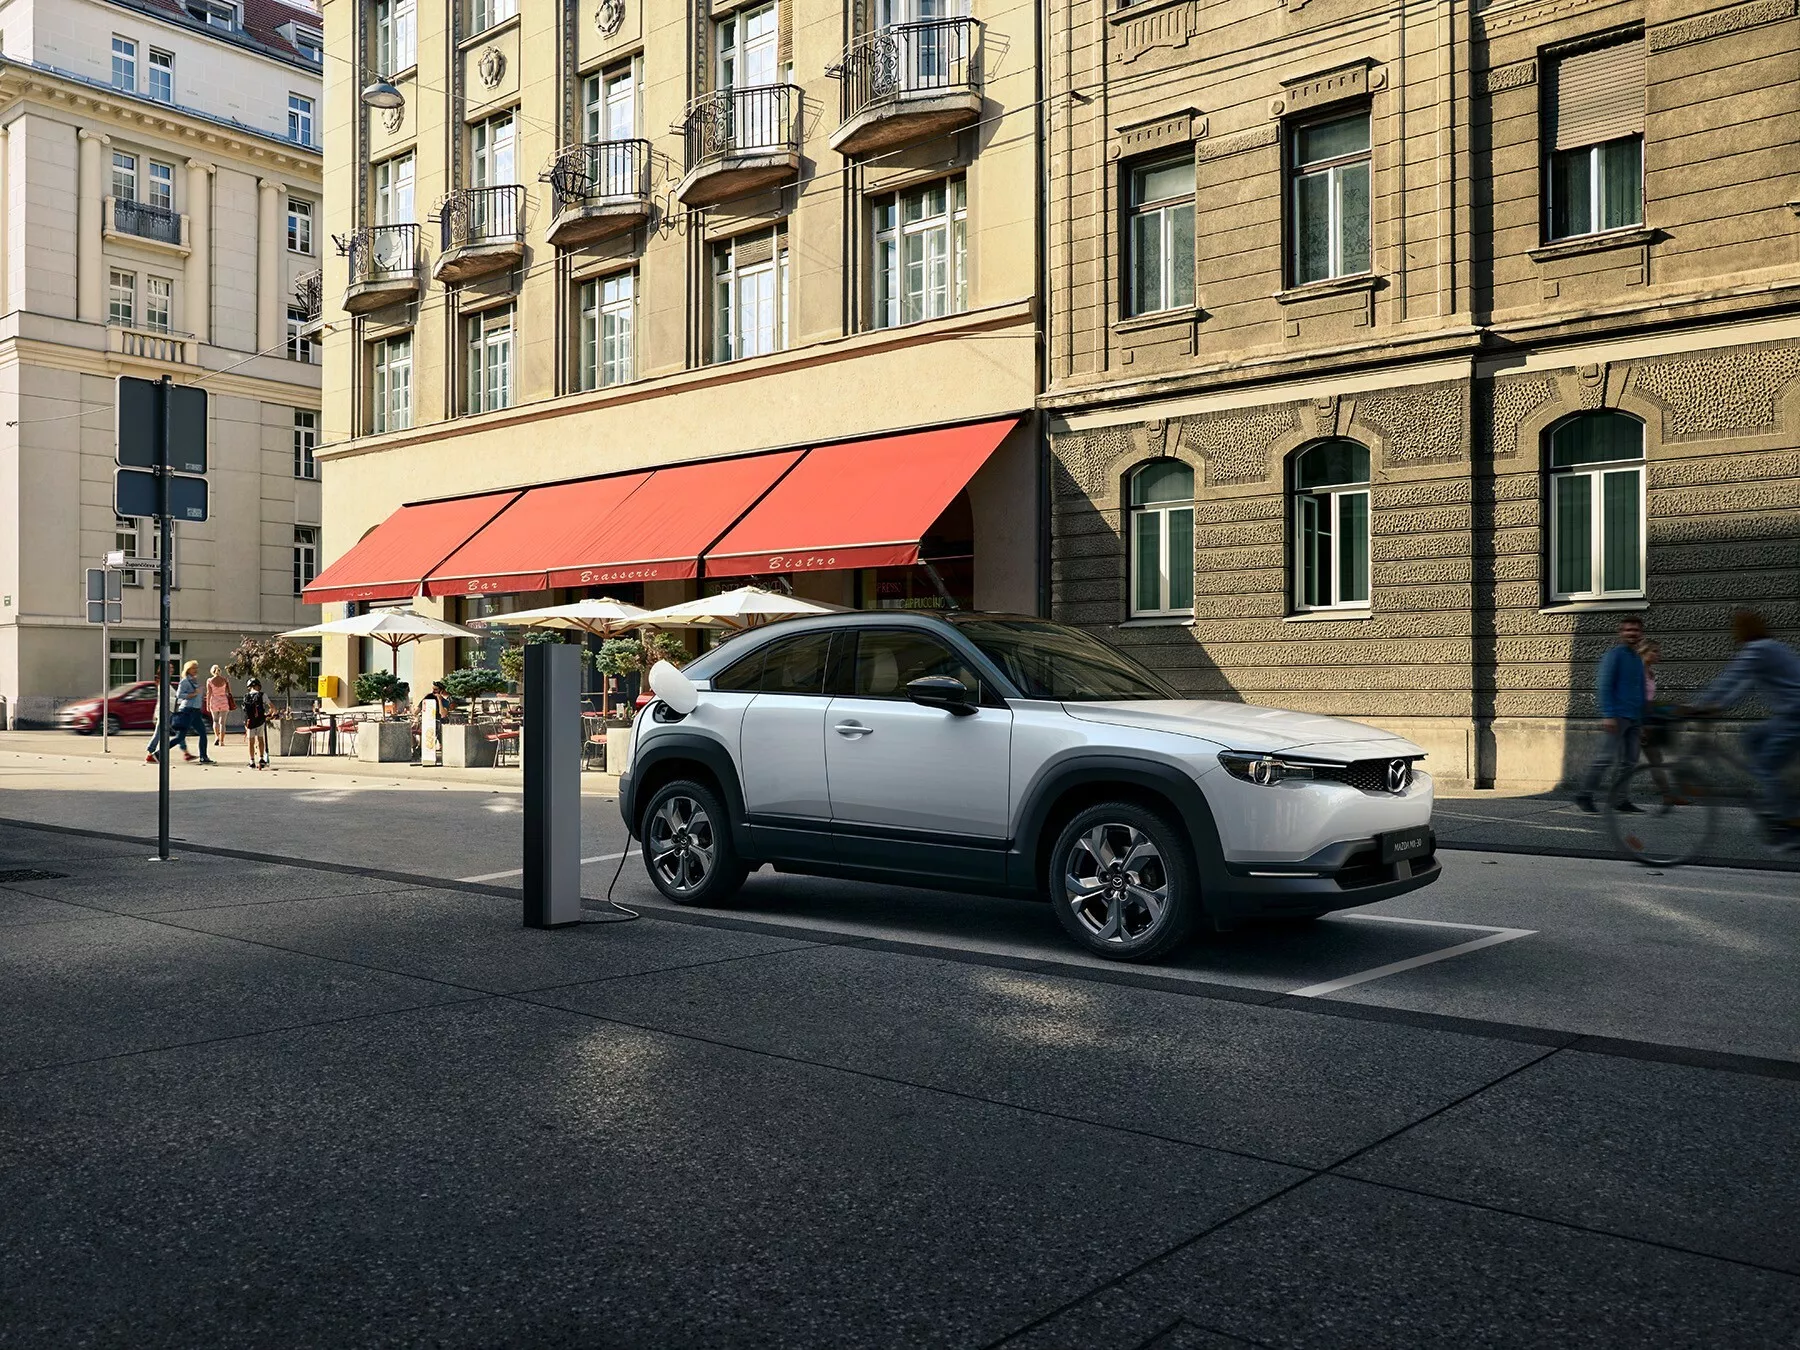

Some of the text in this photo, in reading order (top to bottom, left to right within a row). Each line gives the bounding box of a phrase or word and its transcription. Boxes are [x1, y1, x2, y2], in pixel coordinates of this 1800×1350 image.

[768, 556, 836, 570] Bistro
[580, 568, 658, 582] Brasserie
[467, 579, 499, 591] Bar
[1393, 842, 1410, 852] MAZDA
